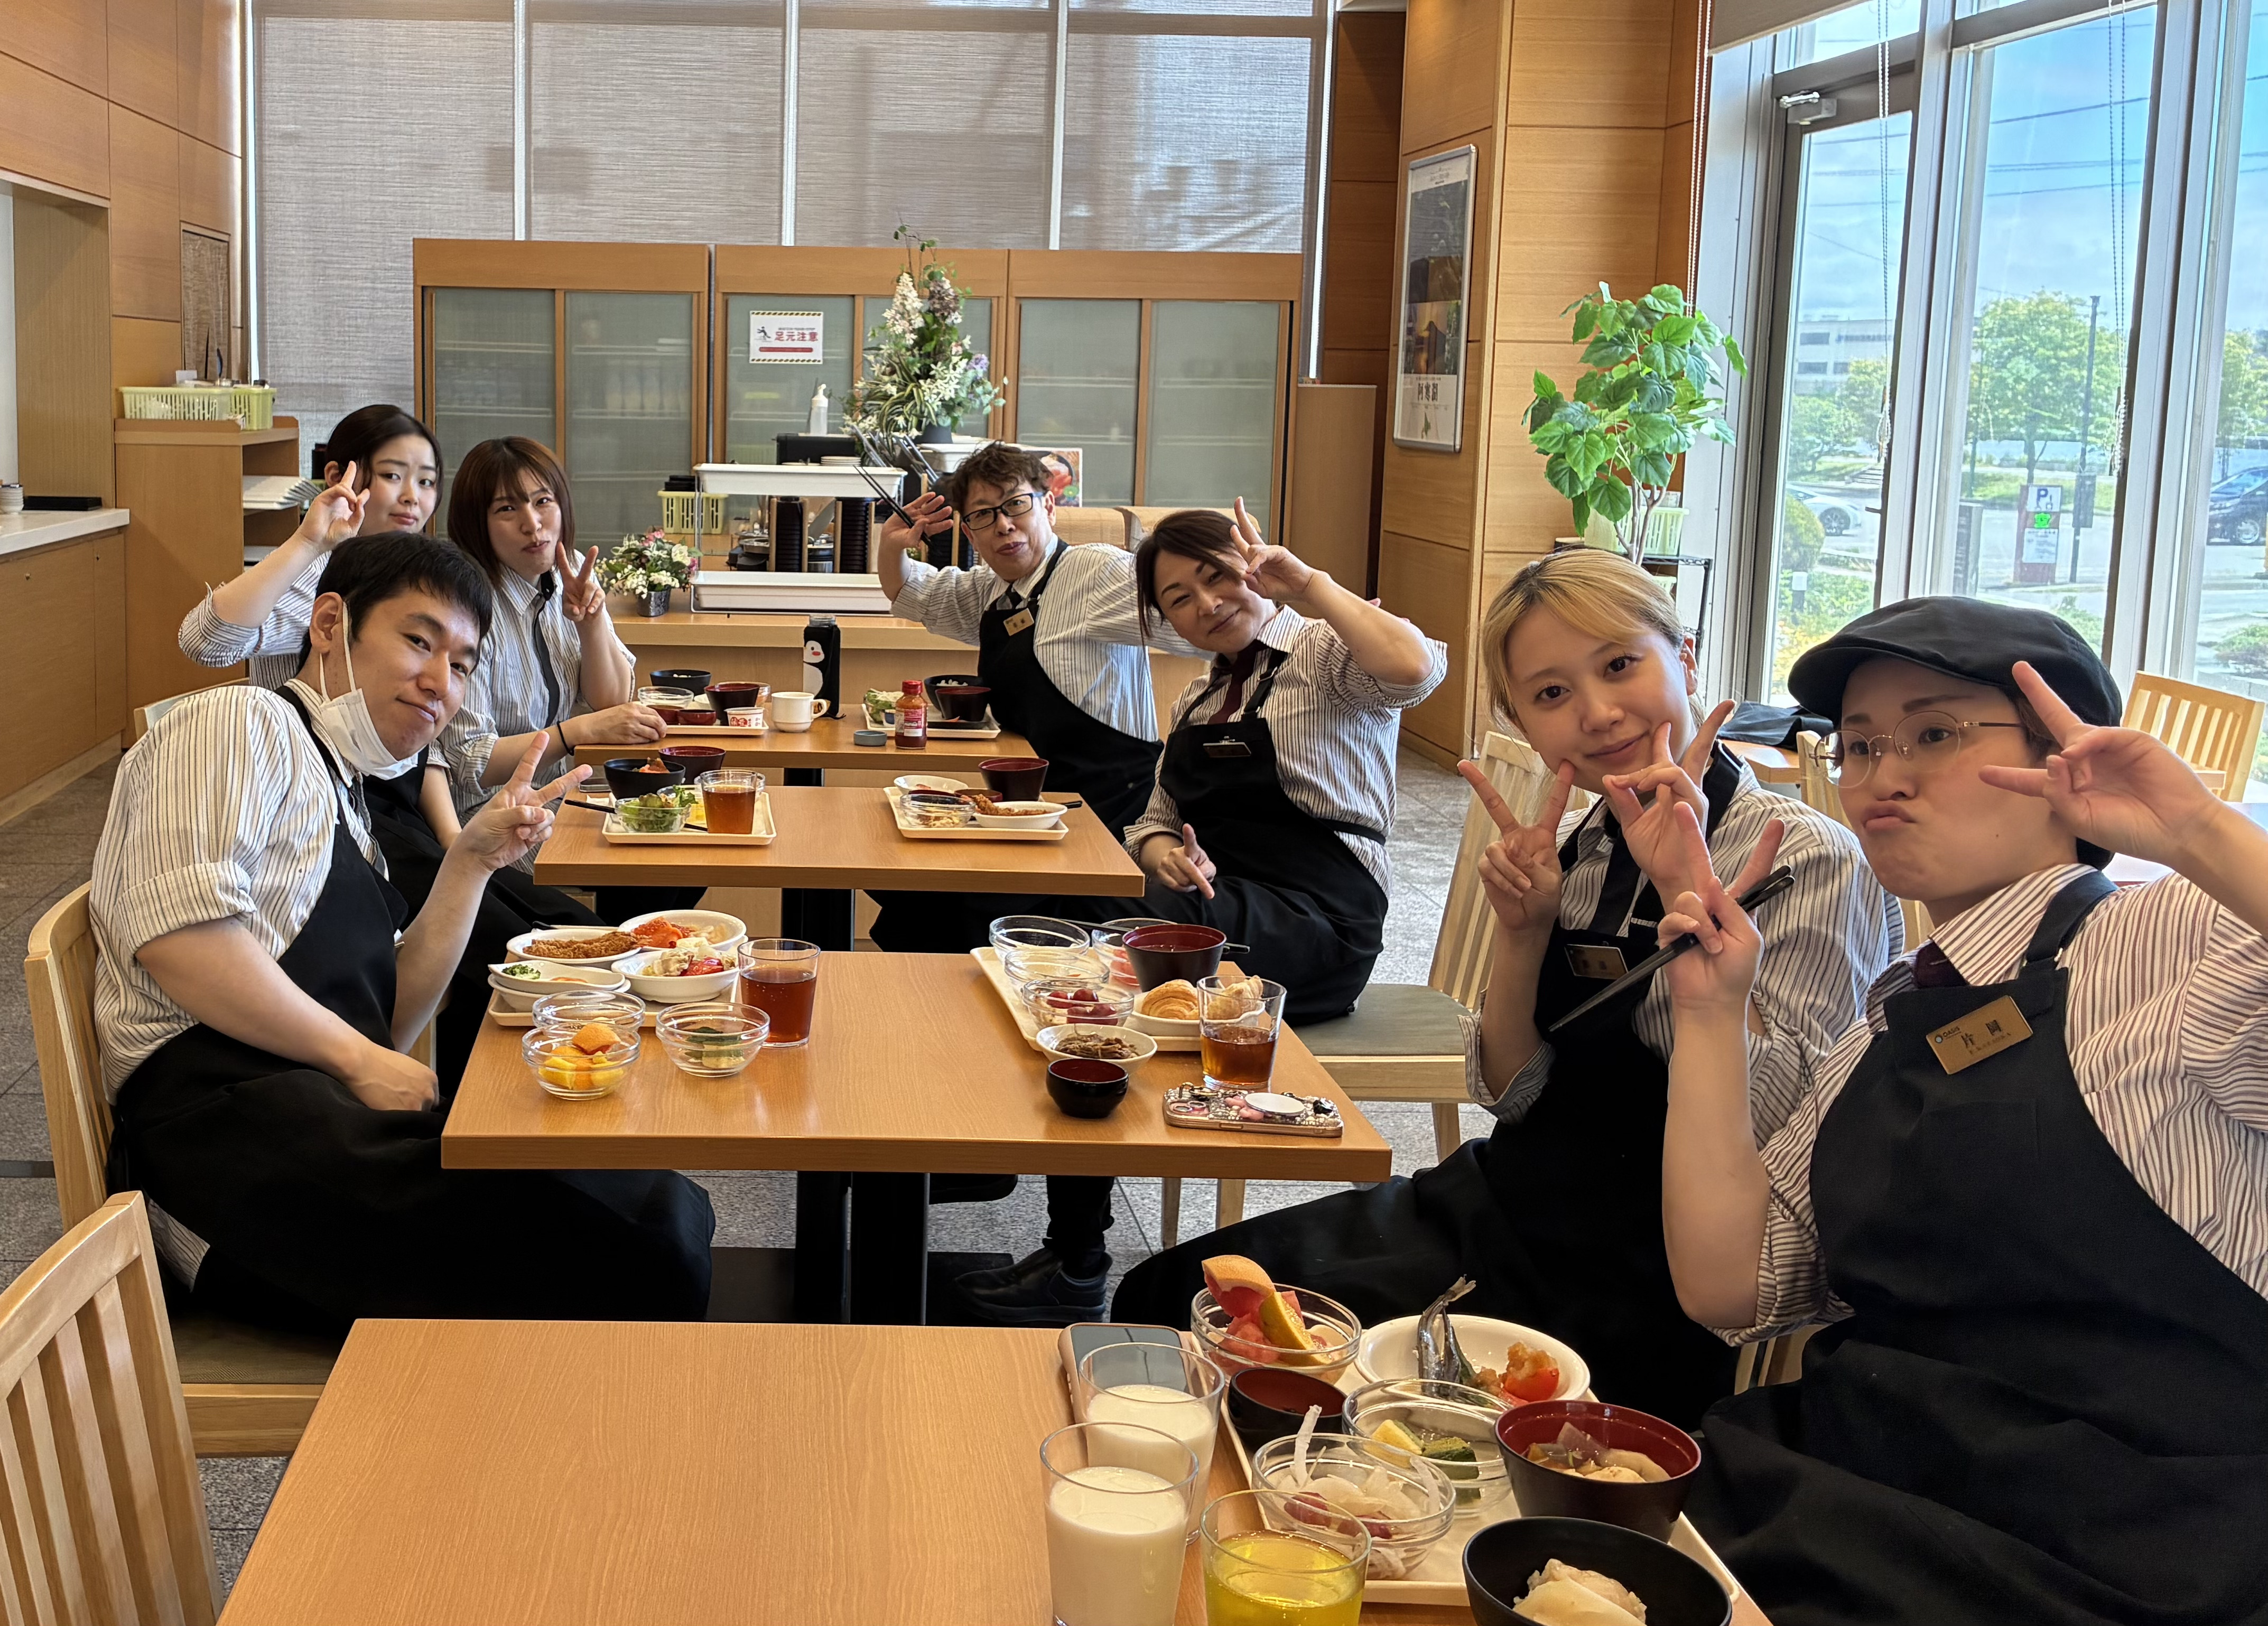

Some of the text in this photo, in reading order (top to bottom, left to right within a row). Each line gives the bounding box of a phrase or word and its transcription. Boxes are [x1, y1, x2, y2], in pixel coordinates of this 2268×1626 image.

[775, 331, 818, 341] 足元注意
[2037, 488, 2048, 502] P
